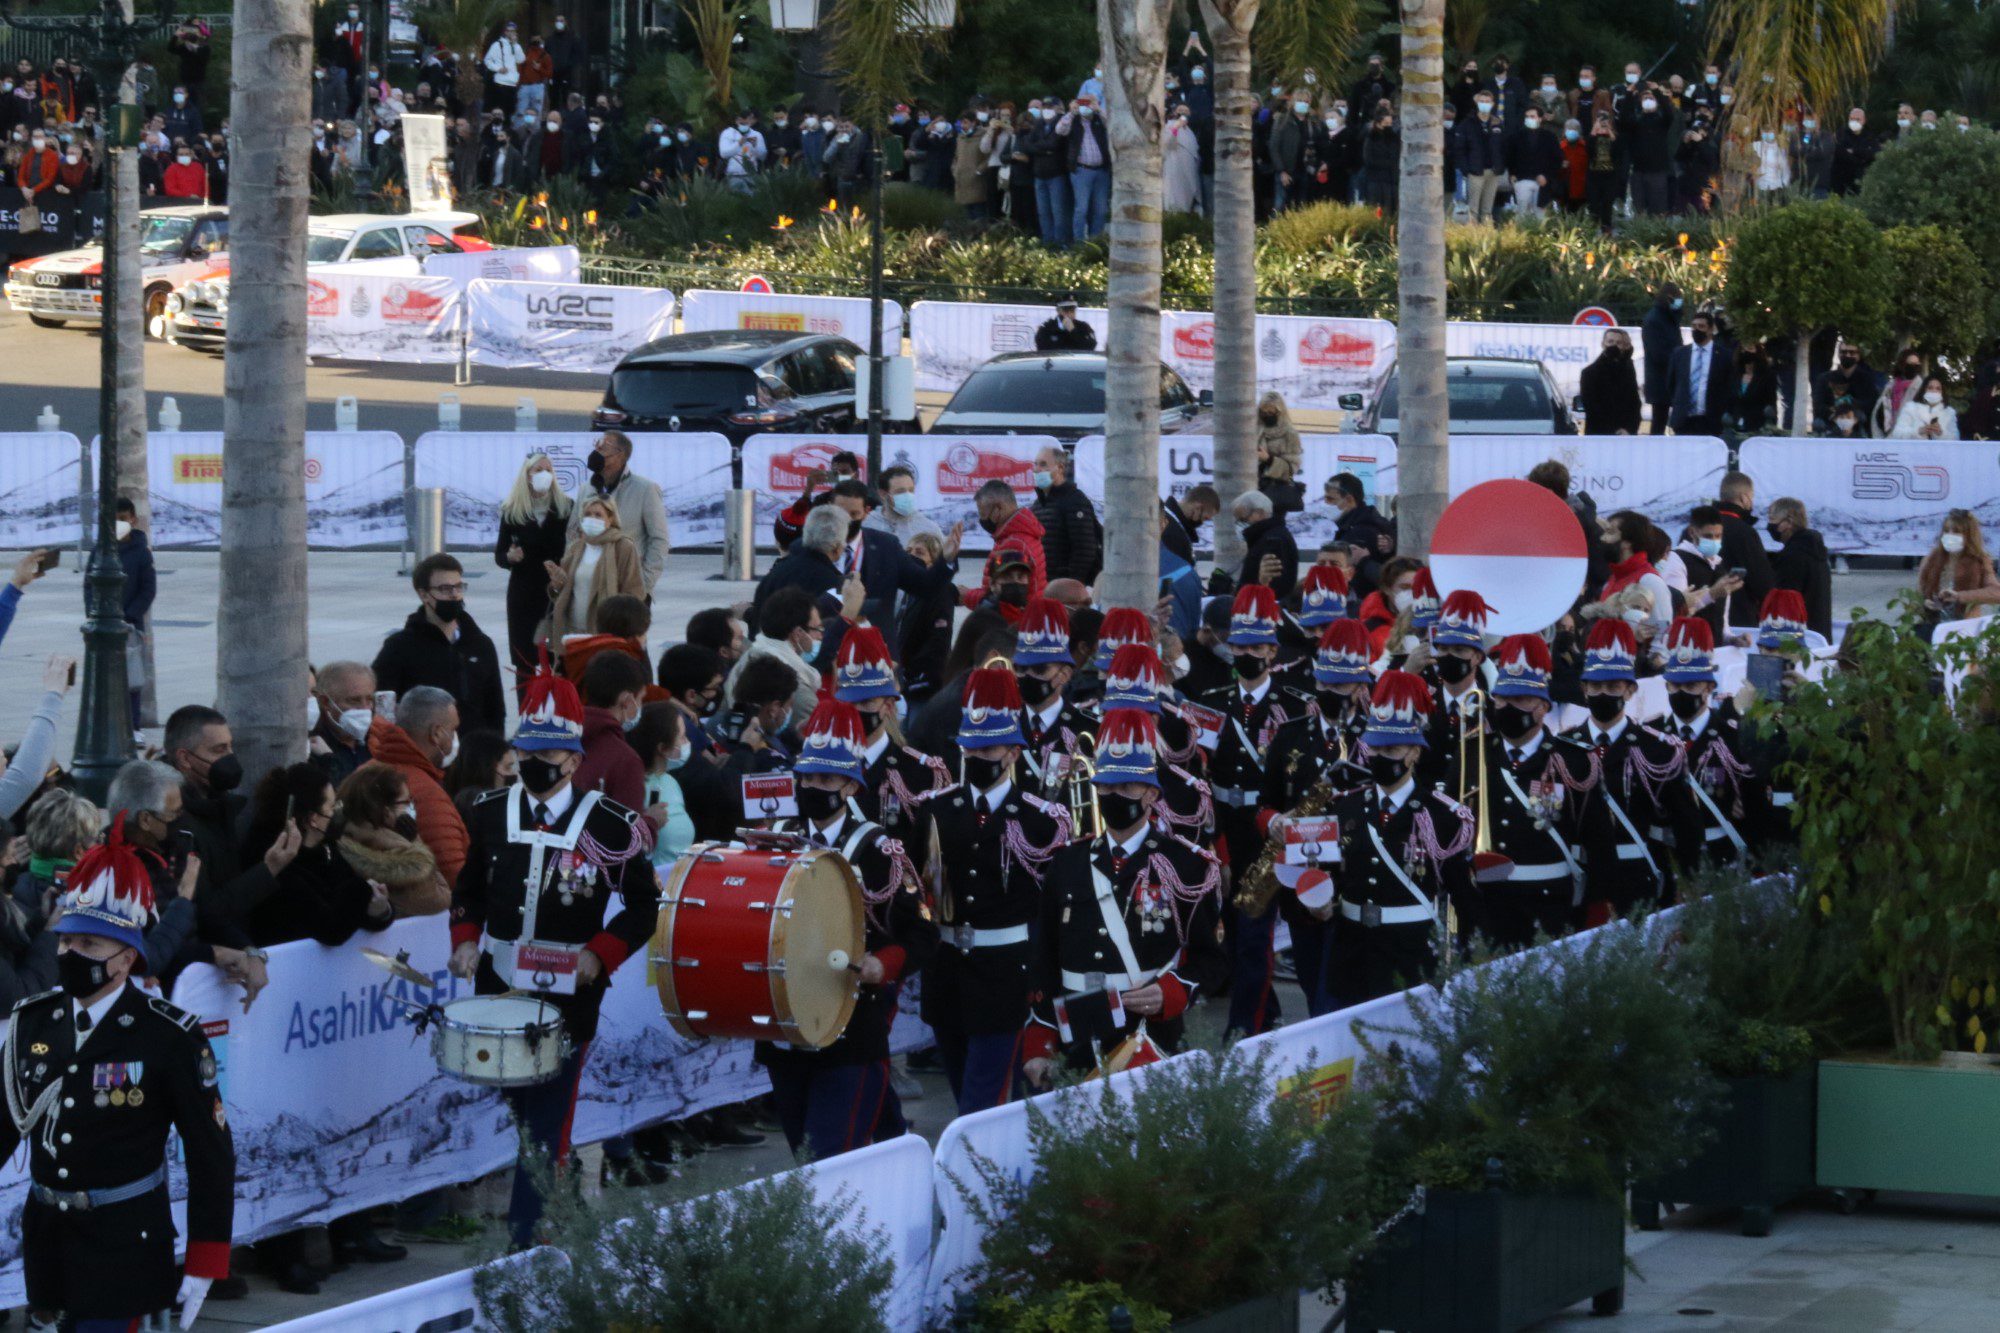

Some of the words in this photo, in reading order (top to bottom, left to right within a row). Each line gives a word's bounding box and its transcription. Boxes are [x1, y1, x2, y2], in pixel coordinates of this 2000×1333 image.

[527, 293, 614, 318] WRC
[1854, 452, 1899, 463] WRC
[1568, 475, 1624, 492] SINO
[1852, 464, 1950, 501] 50
[750, 781, 787, 789] Monaco
[525, 951, 569, 963] Monaco
